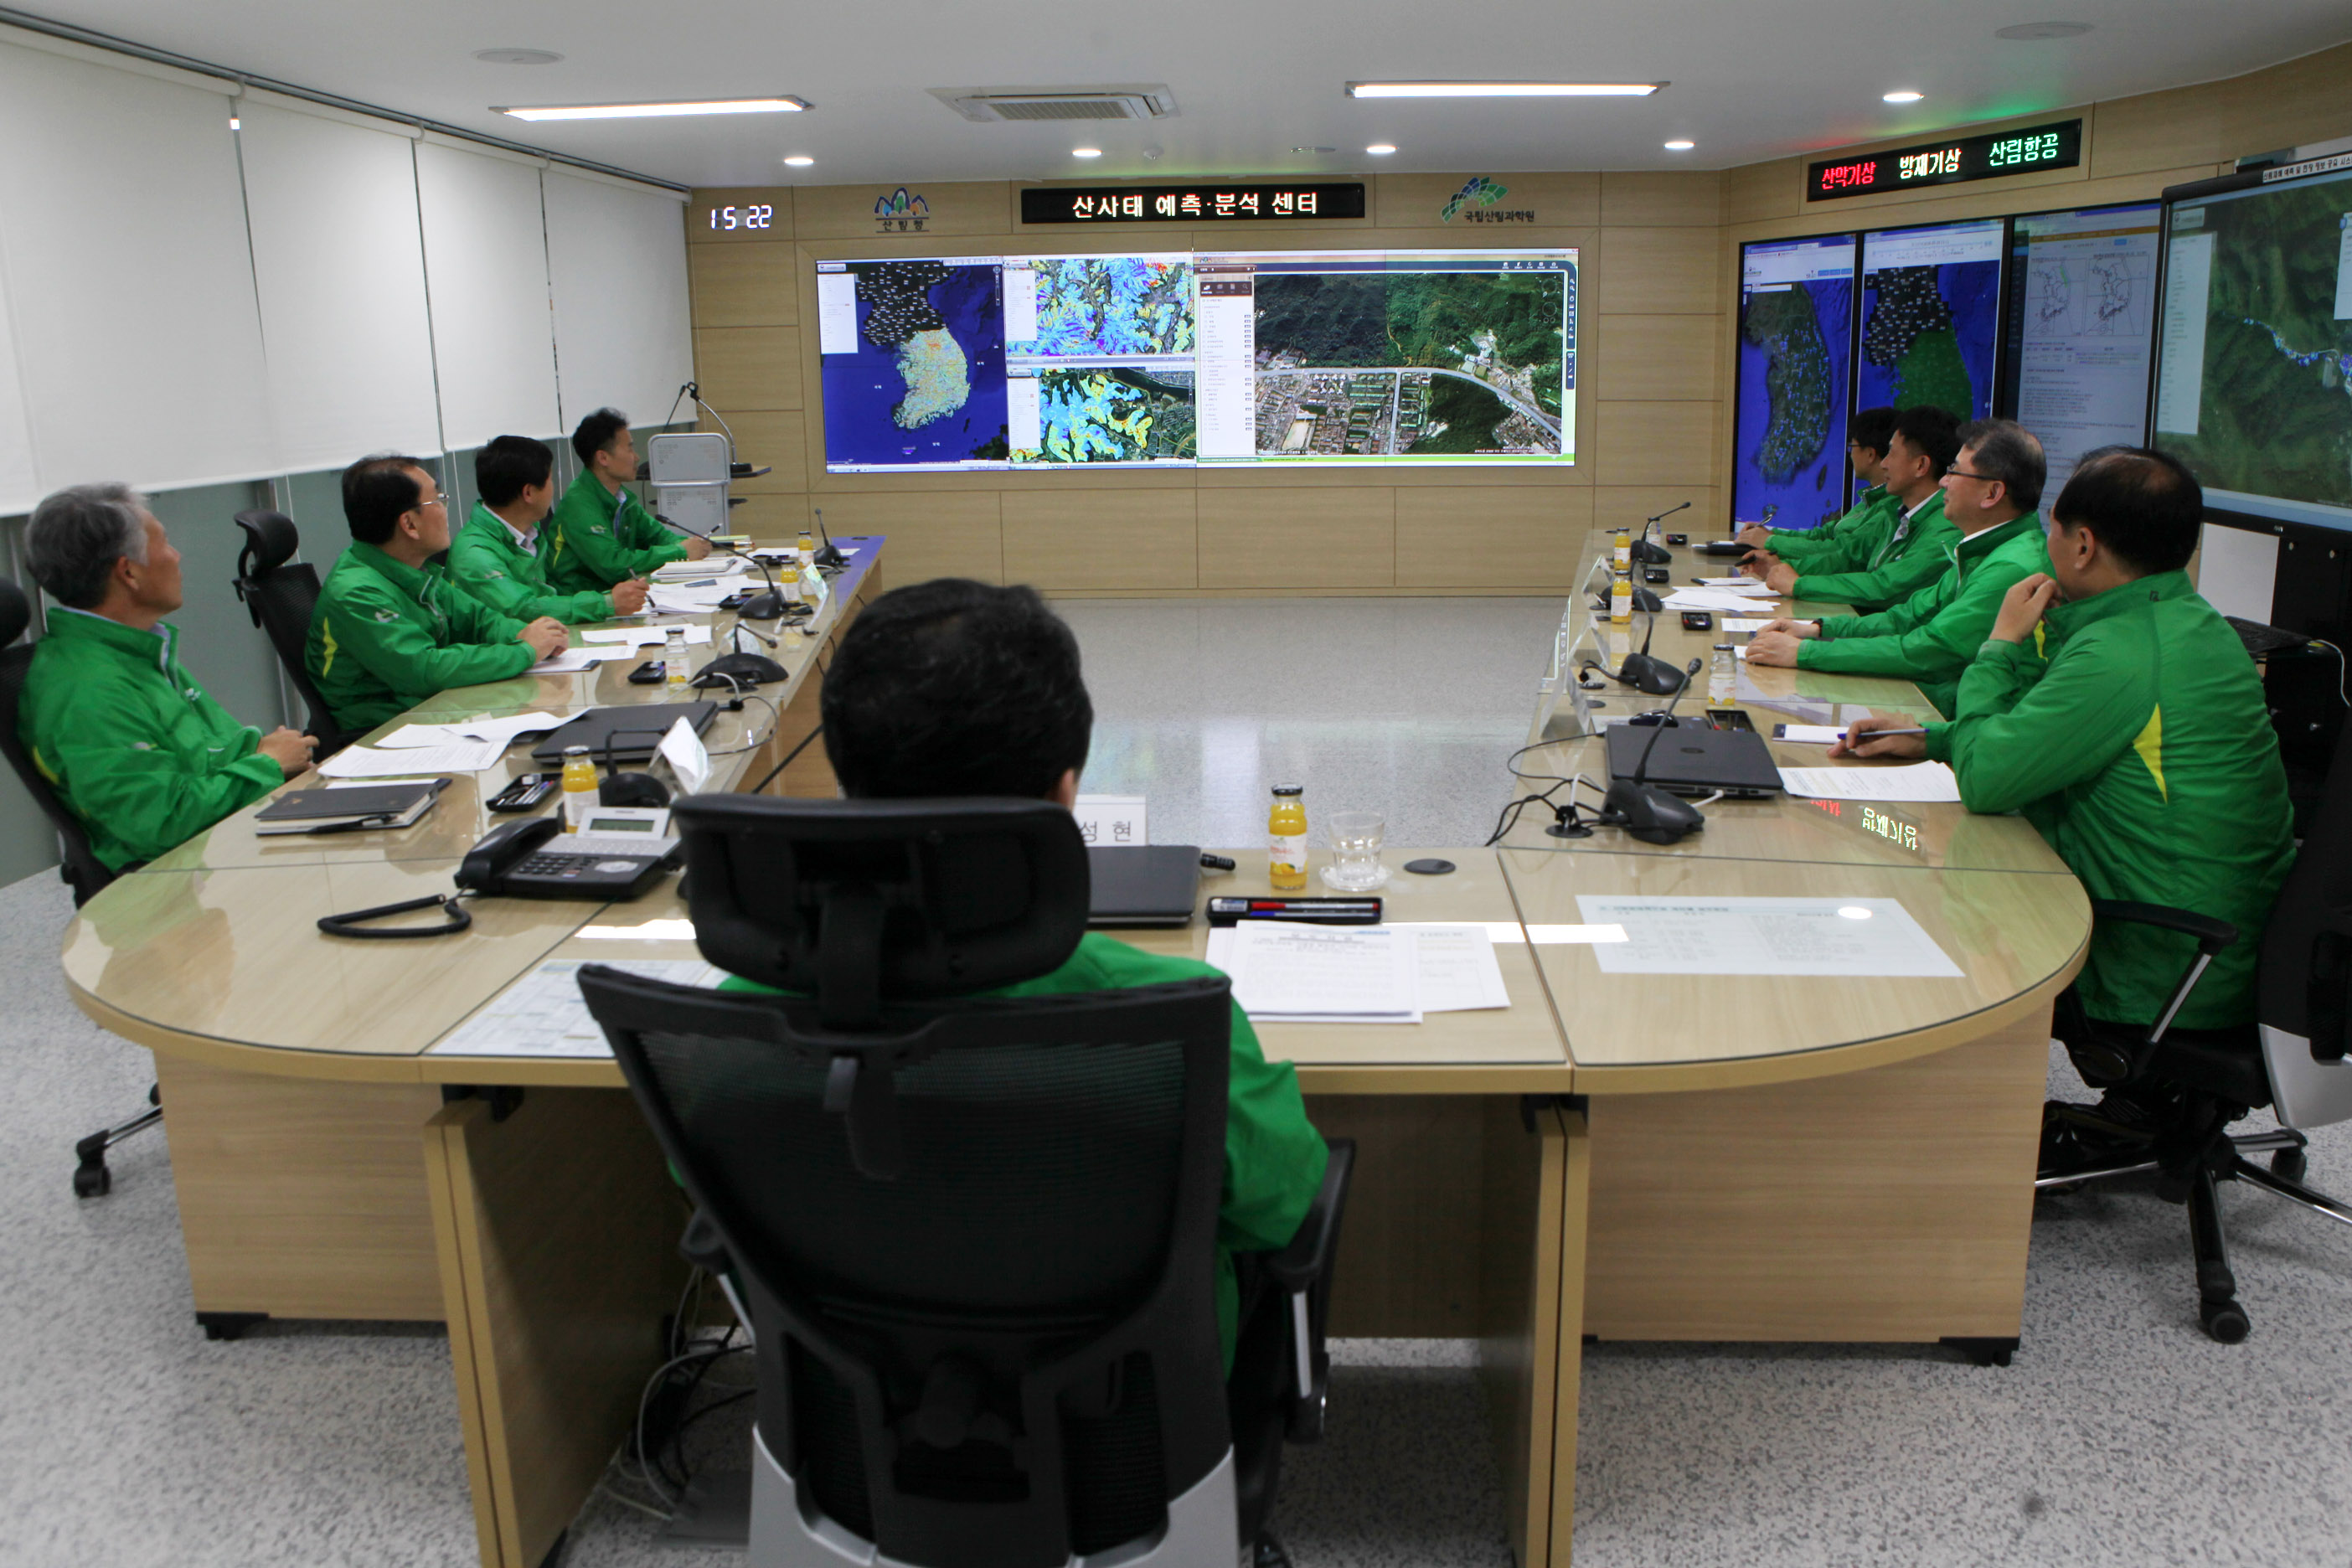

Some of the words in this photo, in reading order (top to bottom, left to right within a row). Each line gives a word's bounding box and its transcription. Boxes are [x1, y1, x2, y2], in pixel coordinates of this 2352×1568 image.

[1900, 147, 1962, 179] 방재기상
[1988, 132, 2059, 167] 산림항공
[2339, 155, 2352, 166] 시스
[1072, 194, 1143, 218] 산사태
[1156, 193, 1259, 217] 예측·분석
[1271, 192, 1317, 215] 센터
[1464, 210, 1534, 223] 국립산림과학원
